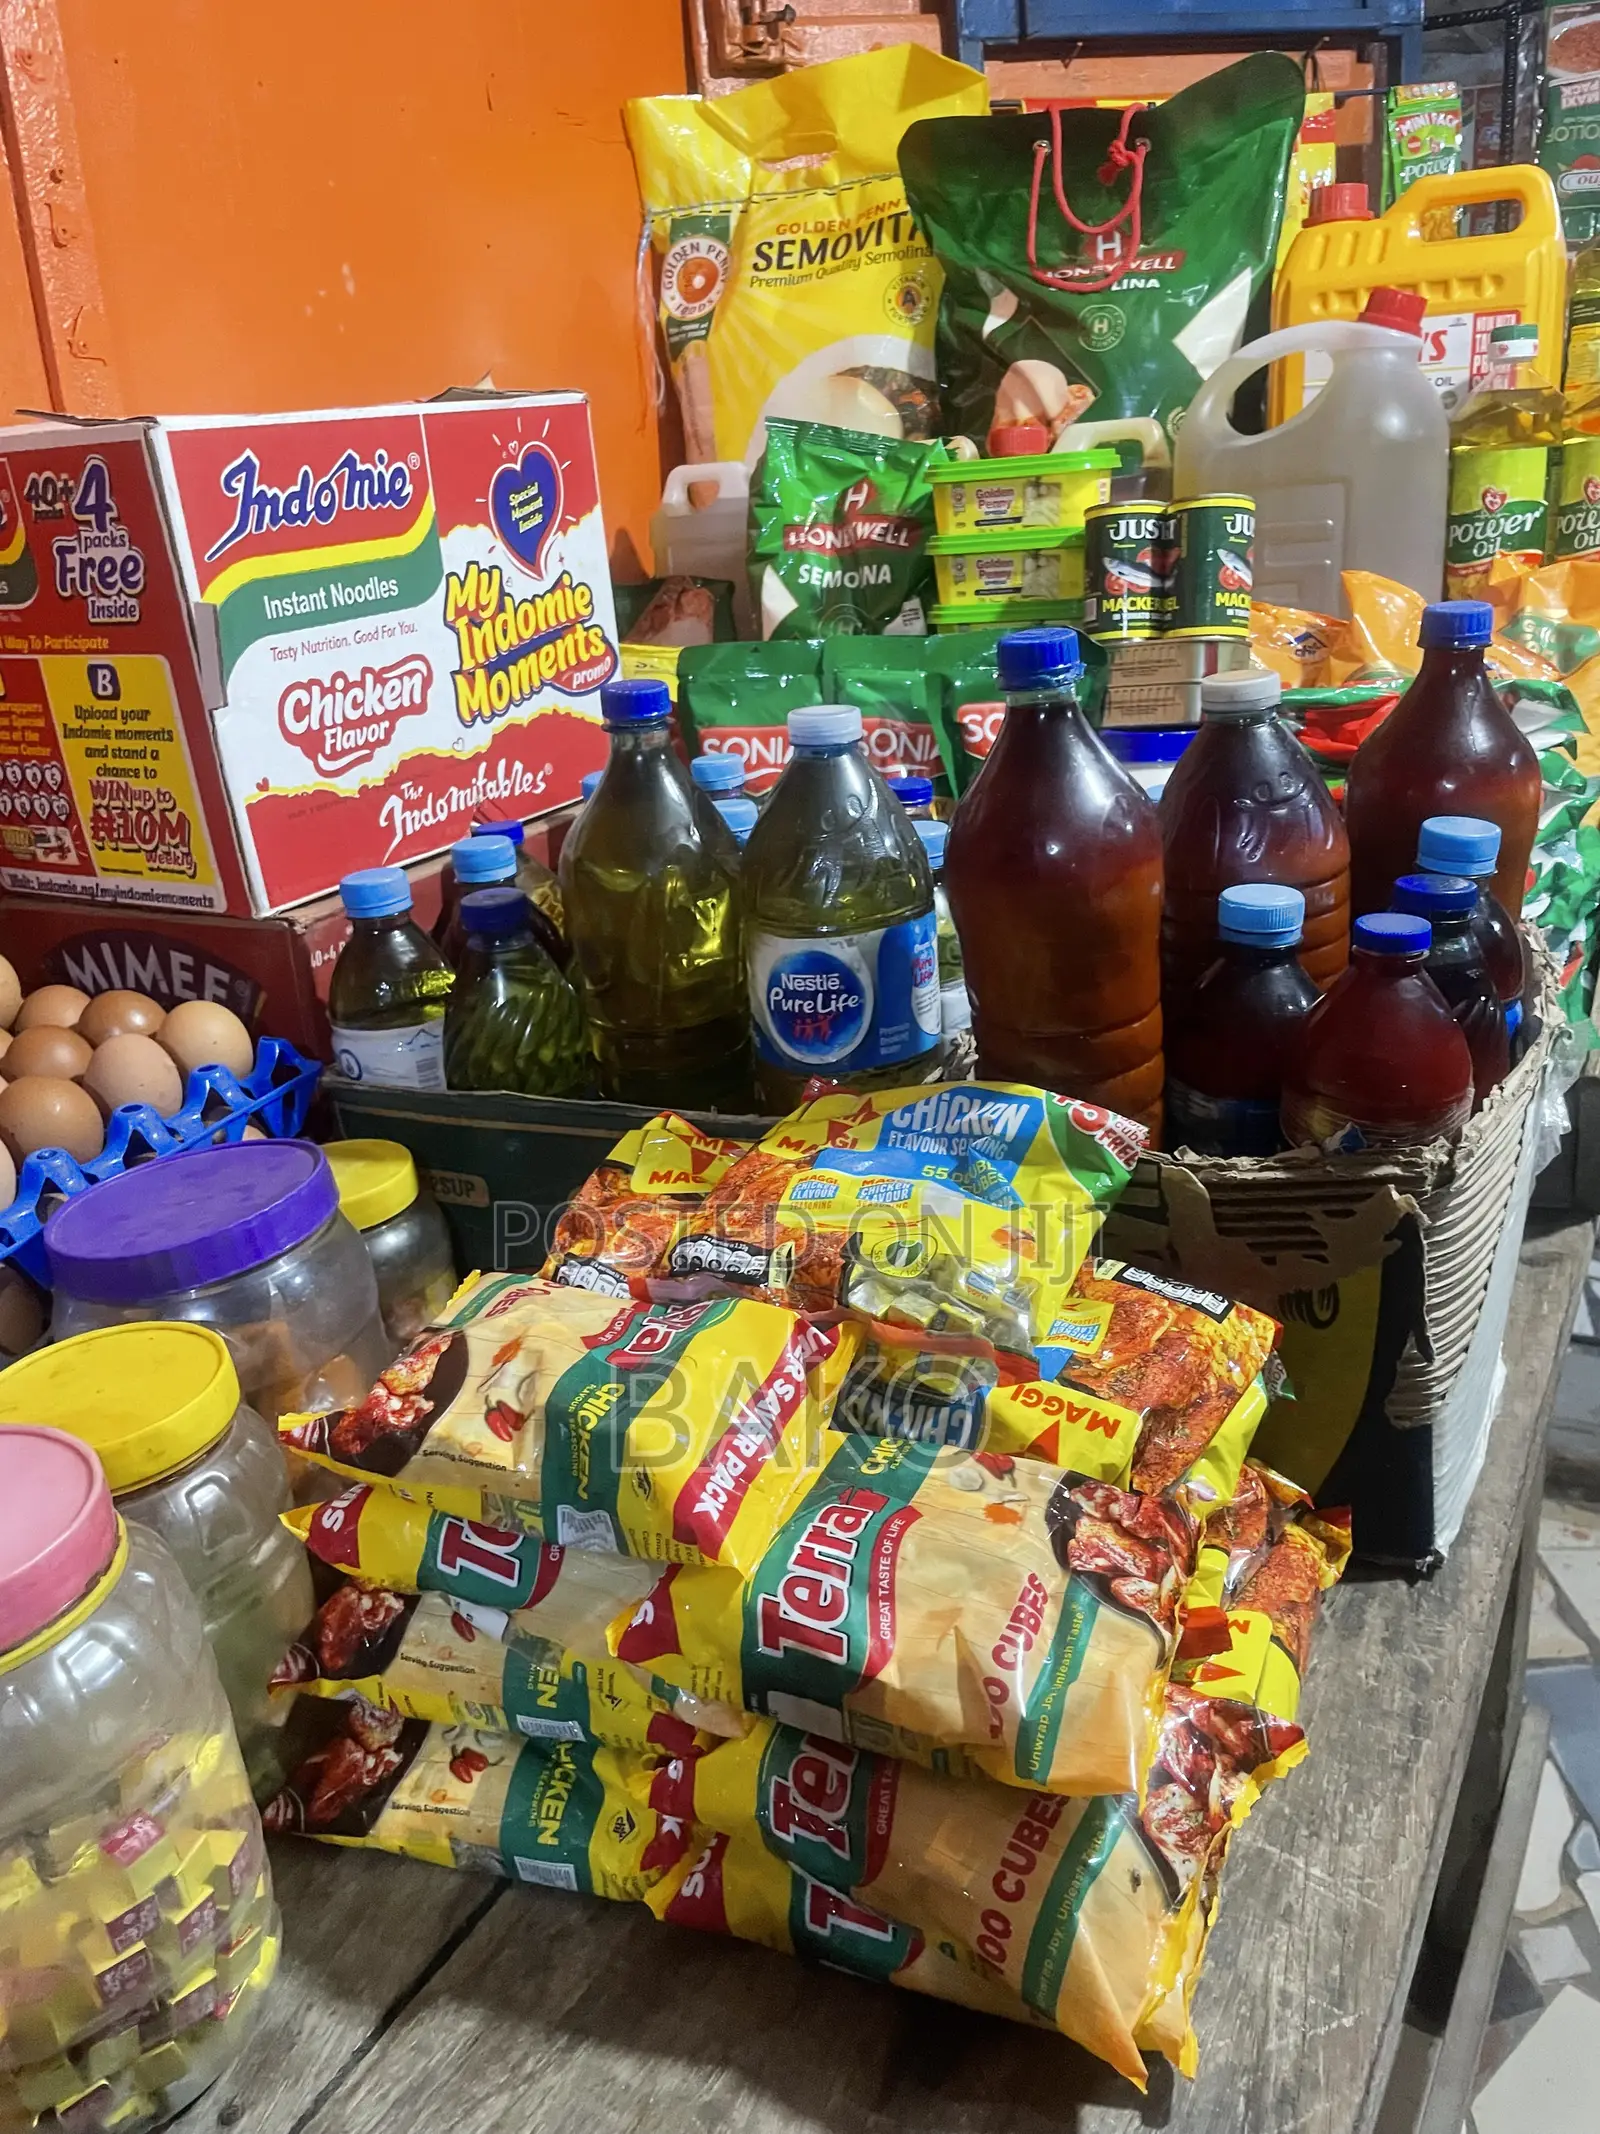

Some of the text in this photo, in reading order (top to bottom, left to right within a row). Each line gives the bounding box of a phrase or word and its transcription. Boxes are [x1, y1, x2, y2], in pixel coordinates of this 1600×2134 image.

[776, 198, 902, 237] GOLDEN PENN
[1096, 230, 1123, 261] H
[750, 272, 812, 288] Premium
[817, 259, 861, 282] Quality
[843, 482, 869, 512] H
[83, 531, 127, 552] packs
[1472, 536, 1502, 557] Oil
[54, 538, 145, 596] Free
[263, 575, 400, 621] Instant Noodles
[446, 564, 503, 624] My
[89, 598, 138, 621] Inside
[455, 570, 595, 671] Indomie
[29, 635, 42, 650] To
[44, 635, 109, 652] Participate
[269, 620, 419, 664] Tasty Nutrition. Good For You.
[95, 668, 113, 698] B
[456, 626, 608, 724] Moments
[571, 659, 612, 692] promo
[282, 660, 428, 735] Chicken
[74, 704, 151, 725] Upload your
[62, 722, 174, 743] Indomie moments
[323, 718, 390, 757] Flavor
[84, 745, 160, 762] and stand a
[95, 764, 157, 780] chance to
[90, 779, 174, 807] WIN up to
[401, 781, 424, 801] The
[145, 850, 195, 870] Weekly
[781, 972, 841, 992] Nestlé
[888, 1130, 948, 1156] FLAVOUR
[921, 1164, 950, 1180] 55
[792, 1187, 836, 1200] FLAVOUR
[1009, 1384, 1122, 1440] MAGGI
[577, 1382, 626, 1501] CHICKEN
[422, 1449, 508, 1473] Serving Suggestion
[692, 1449, 747, 1523] PACK
[757, 1502, 873, 1667] Terra
[878, 1517, 906, 1641] GREAT TASTE OF LIFE
[991, 1571, 1049, 1672] CUBES
[400, 1652, 477, 1675] Serving Suggestion
[1028, 1713, 1050, 1772] Unwrap
[391, 1801, 471, 1816] Serving Suggestion
[876, 1786, 892, 1835] GREAT
